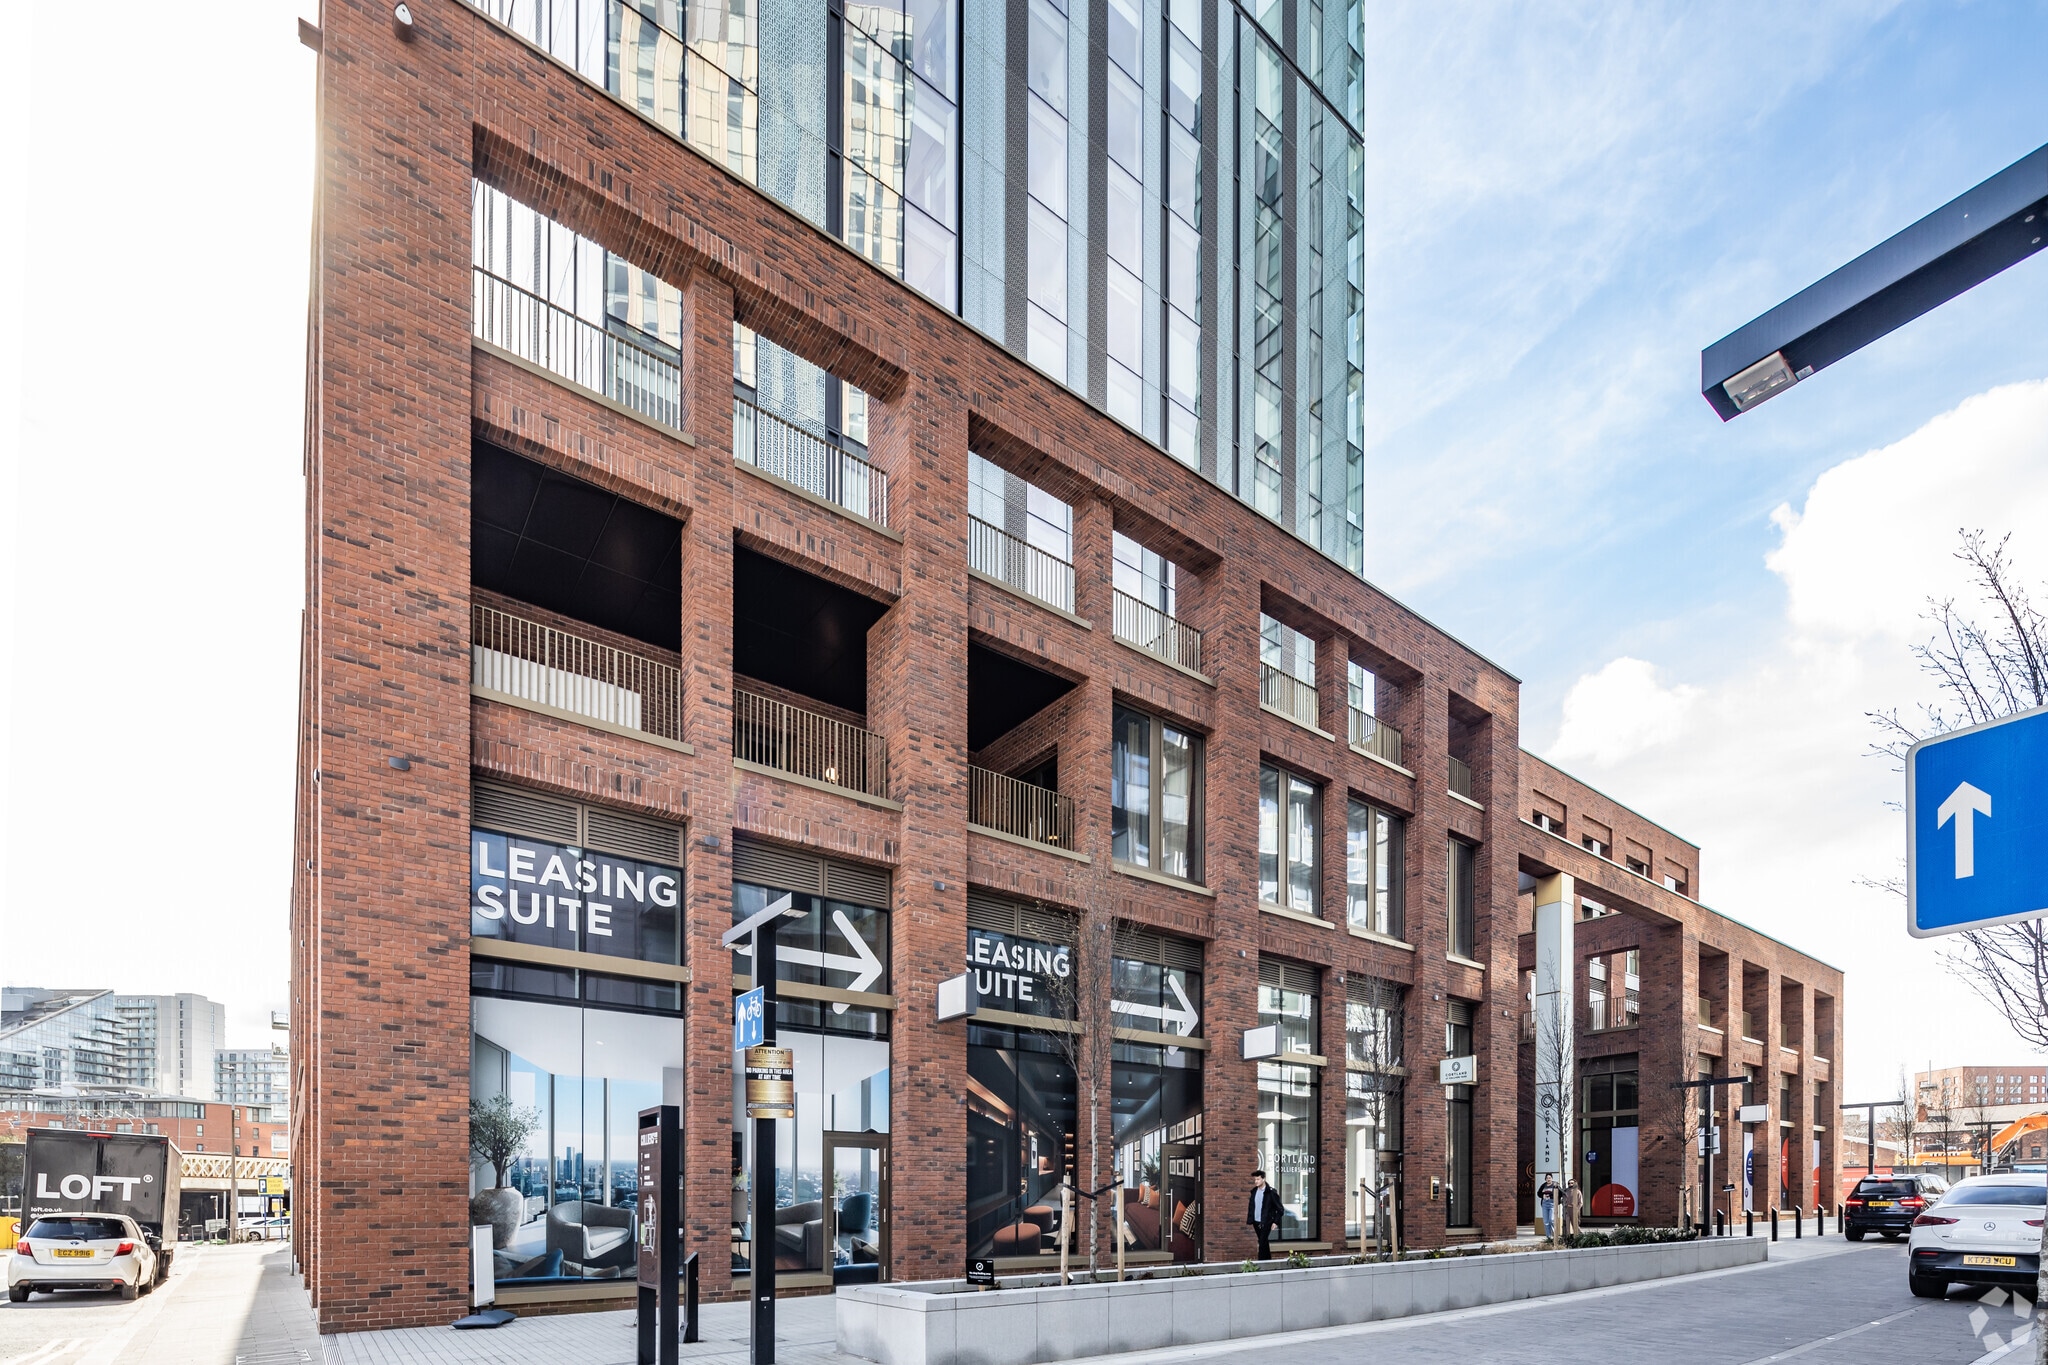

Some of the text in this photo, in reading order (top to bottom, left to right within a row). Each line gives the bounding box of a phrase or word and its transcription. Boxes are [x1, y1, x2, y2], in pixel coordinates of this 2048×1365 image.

[479, 841, 677, 908] LEASING
[476, 884, 613, 937] SUITE
[966, 966, 1034, 1002] UITE
[36, 1172, 141, 1201] LOFT
[1968, 1256, 1992, 1264] KT73
